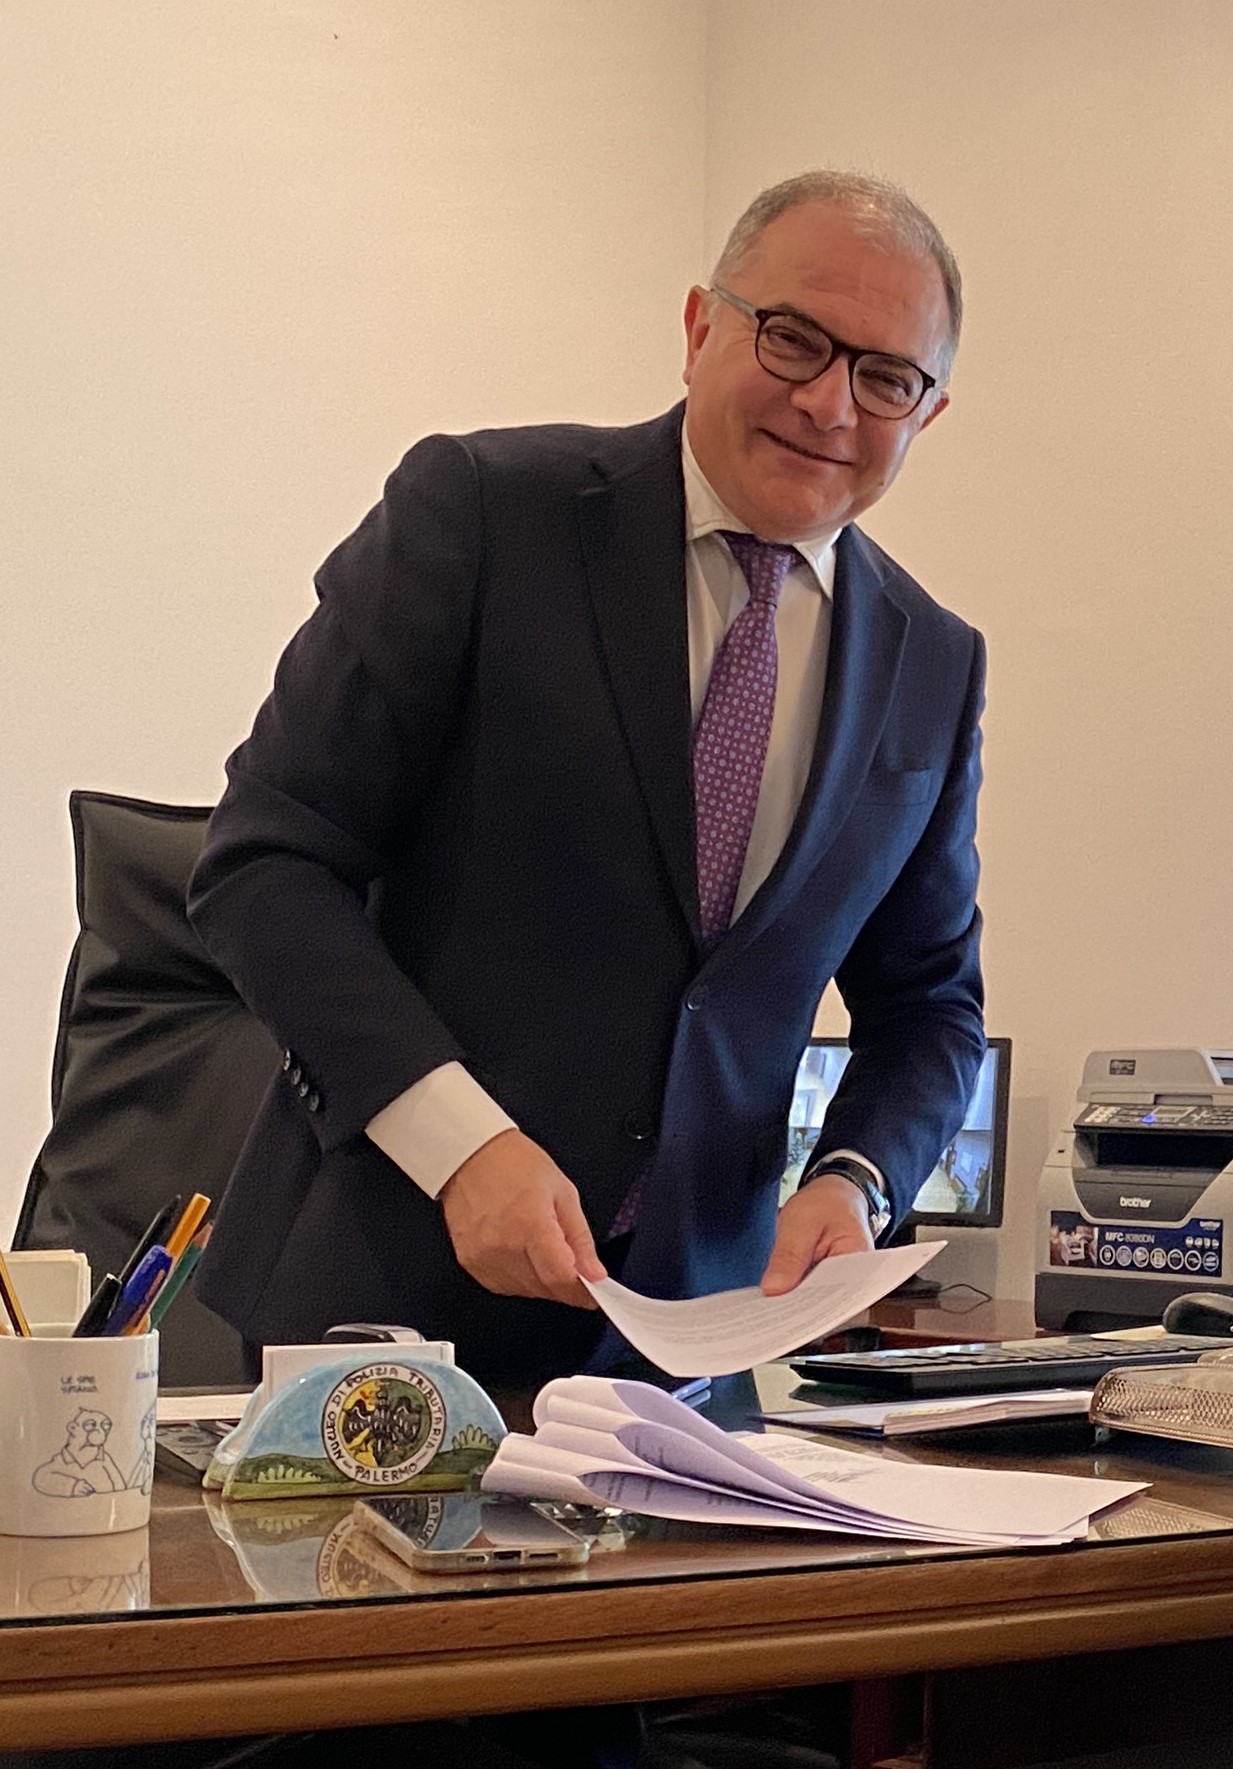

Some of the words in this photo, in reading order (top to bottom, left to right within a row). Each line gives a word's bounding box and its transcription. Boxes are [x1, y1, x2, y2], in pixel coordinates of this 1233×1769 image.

[1120, 1196, 1152, 1208] brother
[331, 1390, 346, 1407] DI
[346, 1367, 398, 1388] POLIZIA
[409, 1372, 442, 1449] TRIBUTARIA
[354, 1462, 418, 1483] PALERMO
